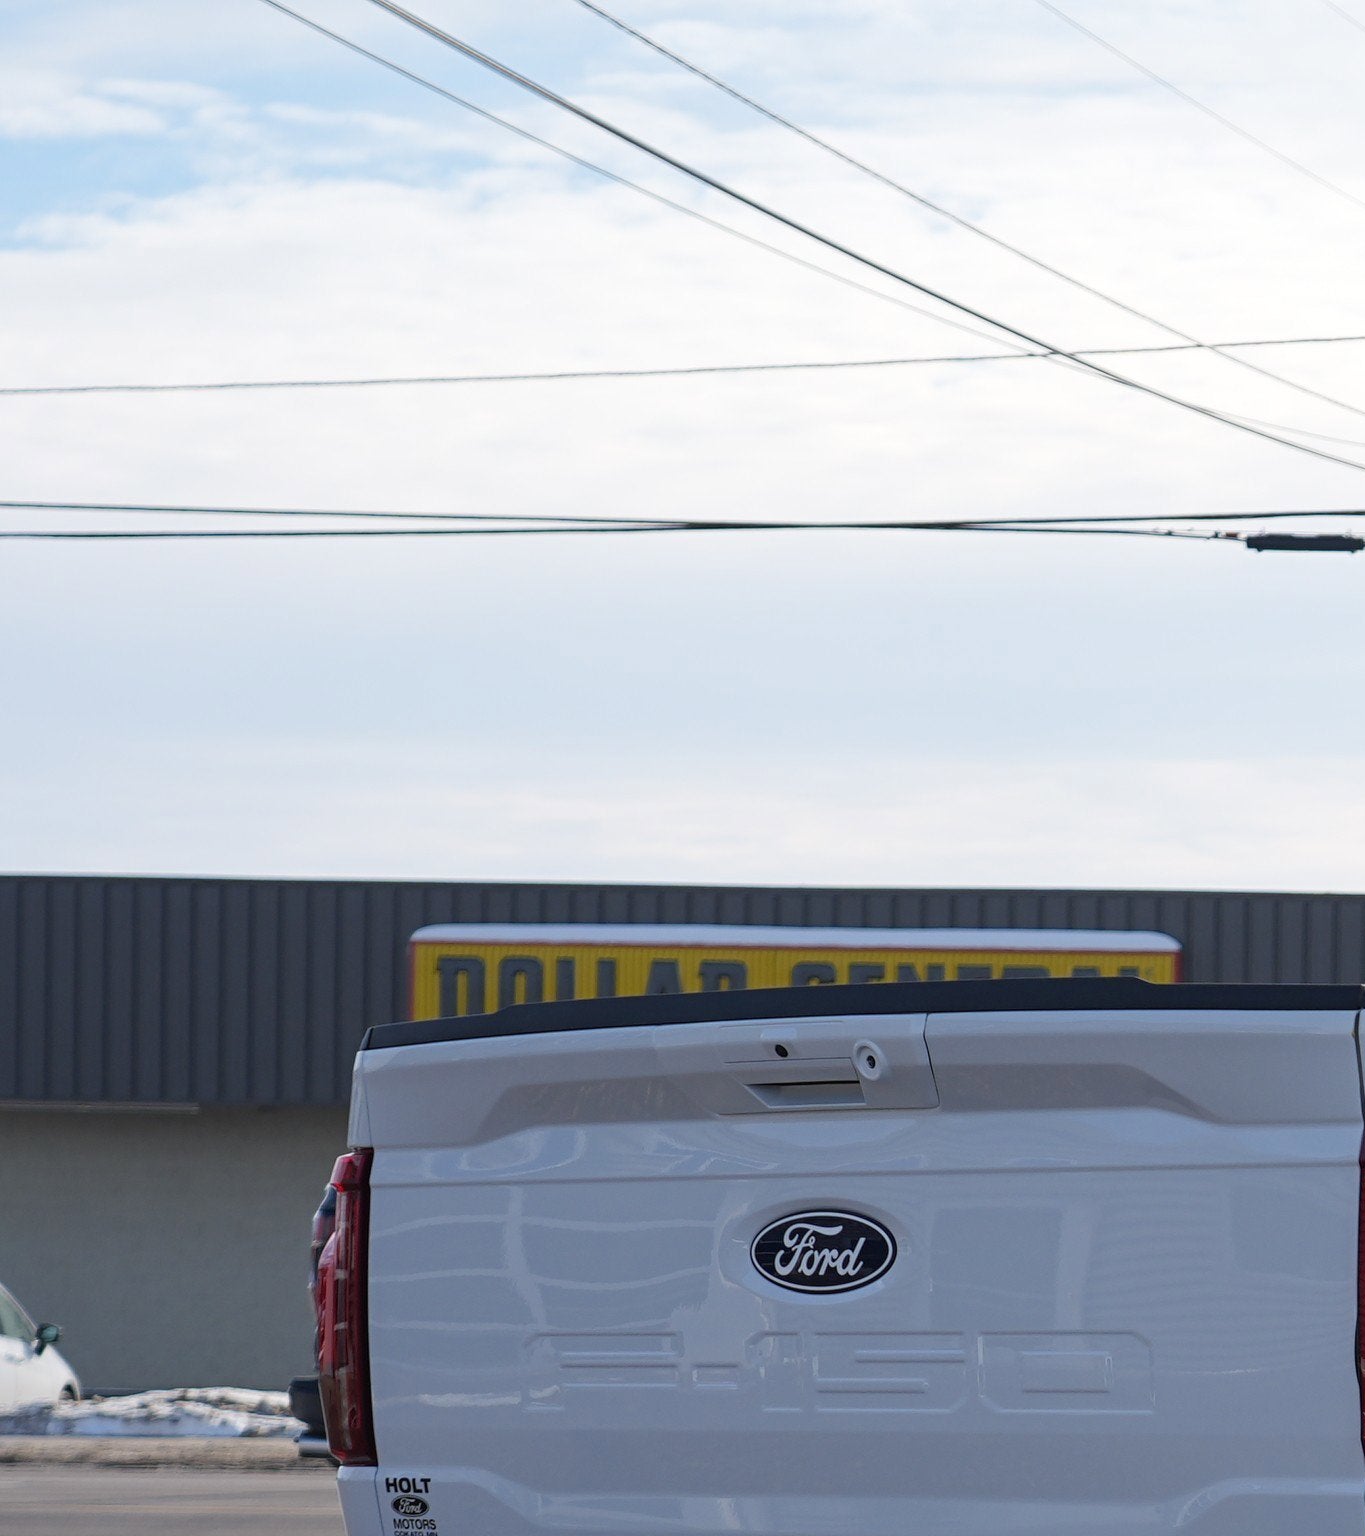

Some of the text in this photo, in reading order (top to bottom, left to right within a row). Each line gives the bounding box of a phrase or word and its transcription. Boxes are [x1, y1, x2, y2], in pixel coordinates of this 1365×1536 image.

[774, 1223, 866, 1276] Ford
[385, 1477, 431, 1494] HOLT
[399, 1497, 423, 1514] Ford
[393, 1518, 437, 1530] MOTORS
